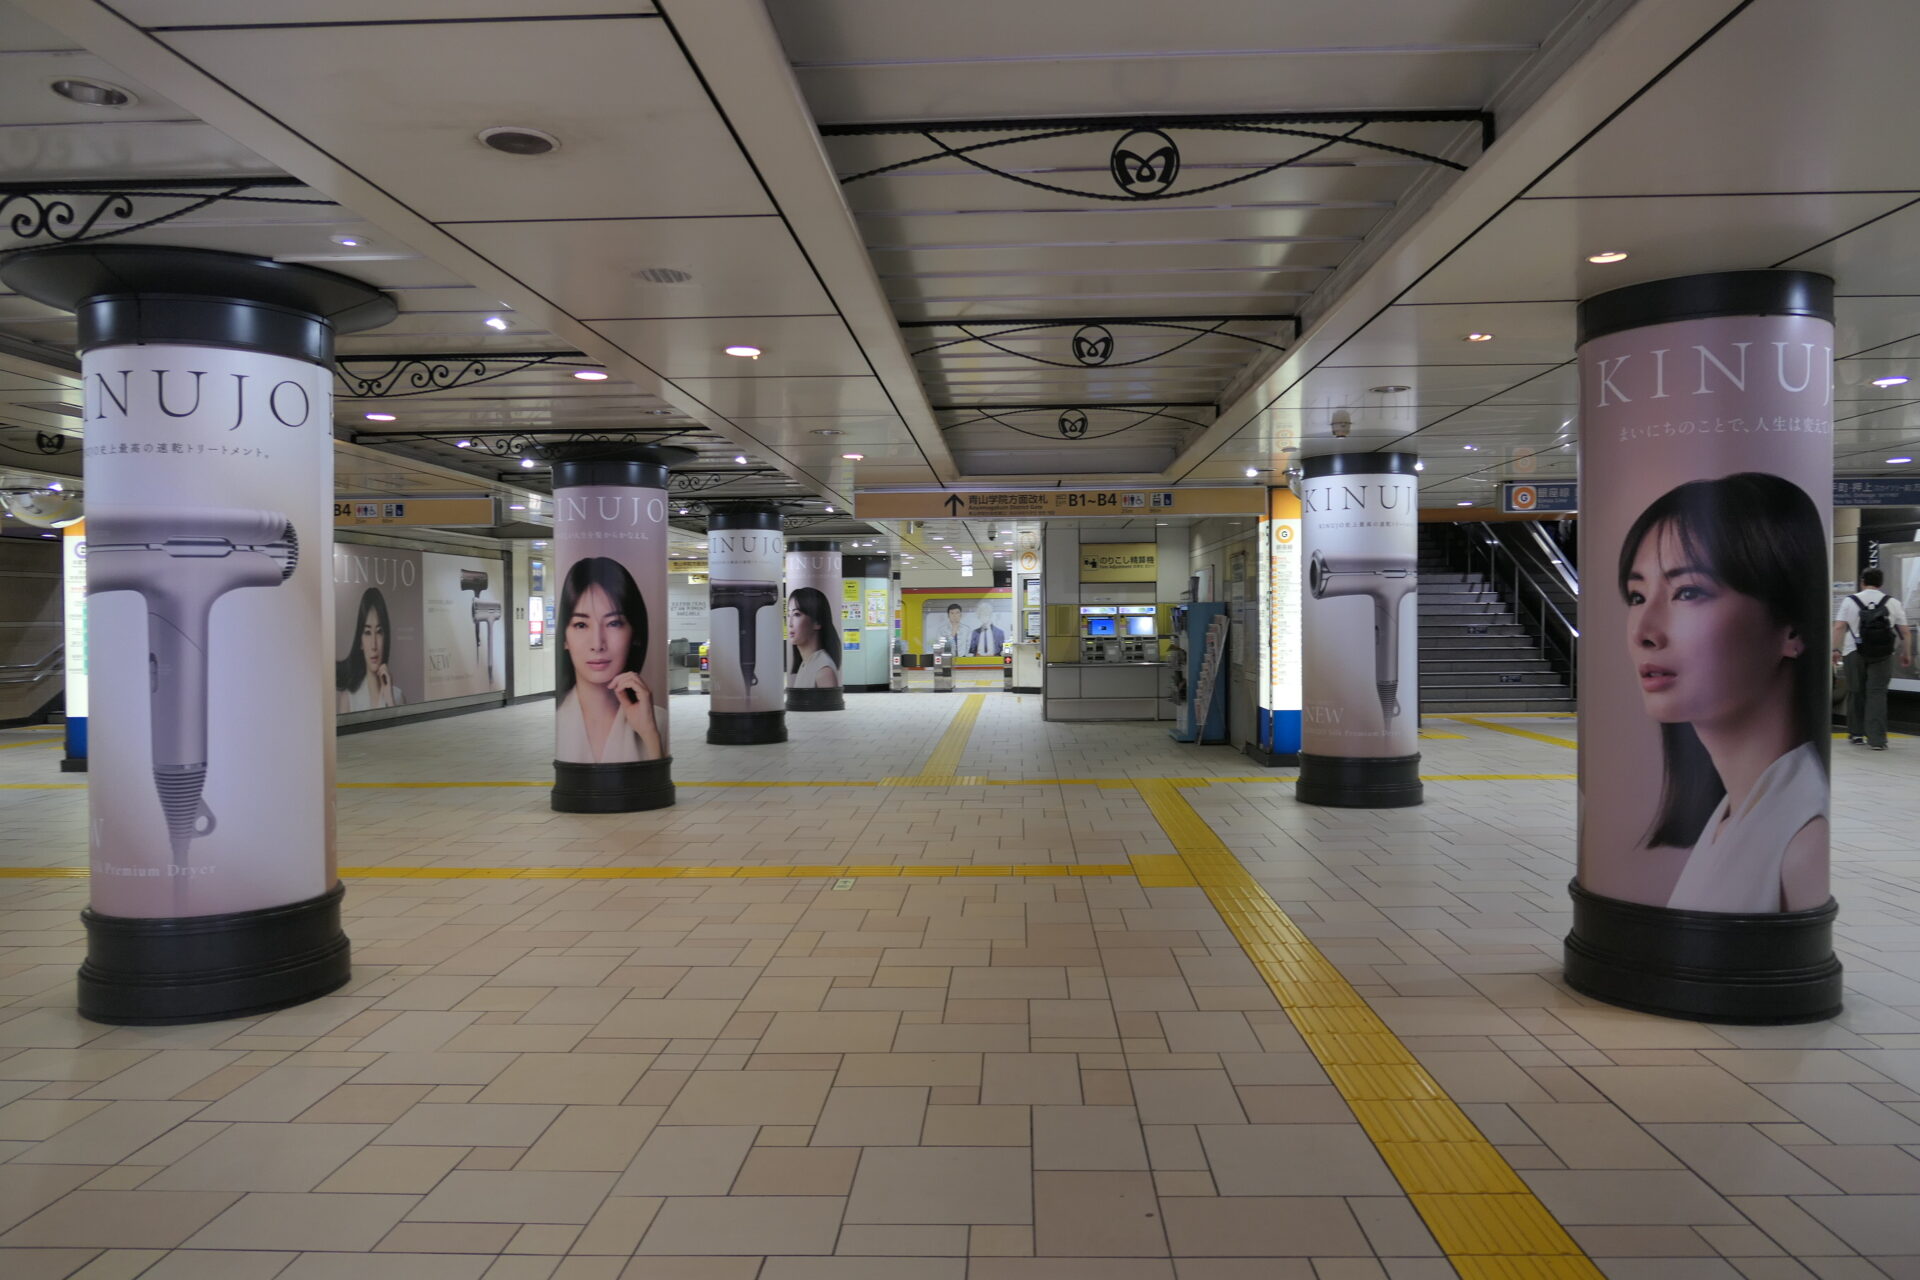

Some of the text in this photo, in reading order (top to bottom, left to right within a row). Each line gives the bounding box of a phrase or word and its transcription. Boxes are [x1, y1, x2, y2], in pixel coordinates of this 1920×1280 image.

[968, 494, 1049, 505] 青山学院方面改札
[1305, 485, 1417, 516] KINUJ
[1520, 493, 1529, 502] G
[1281, 530, 1288, 538] G
[168, 864, 217, 880] Dryer
